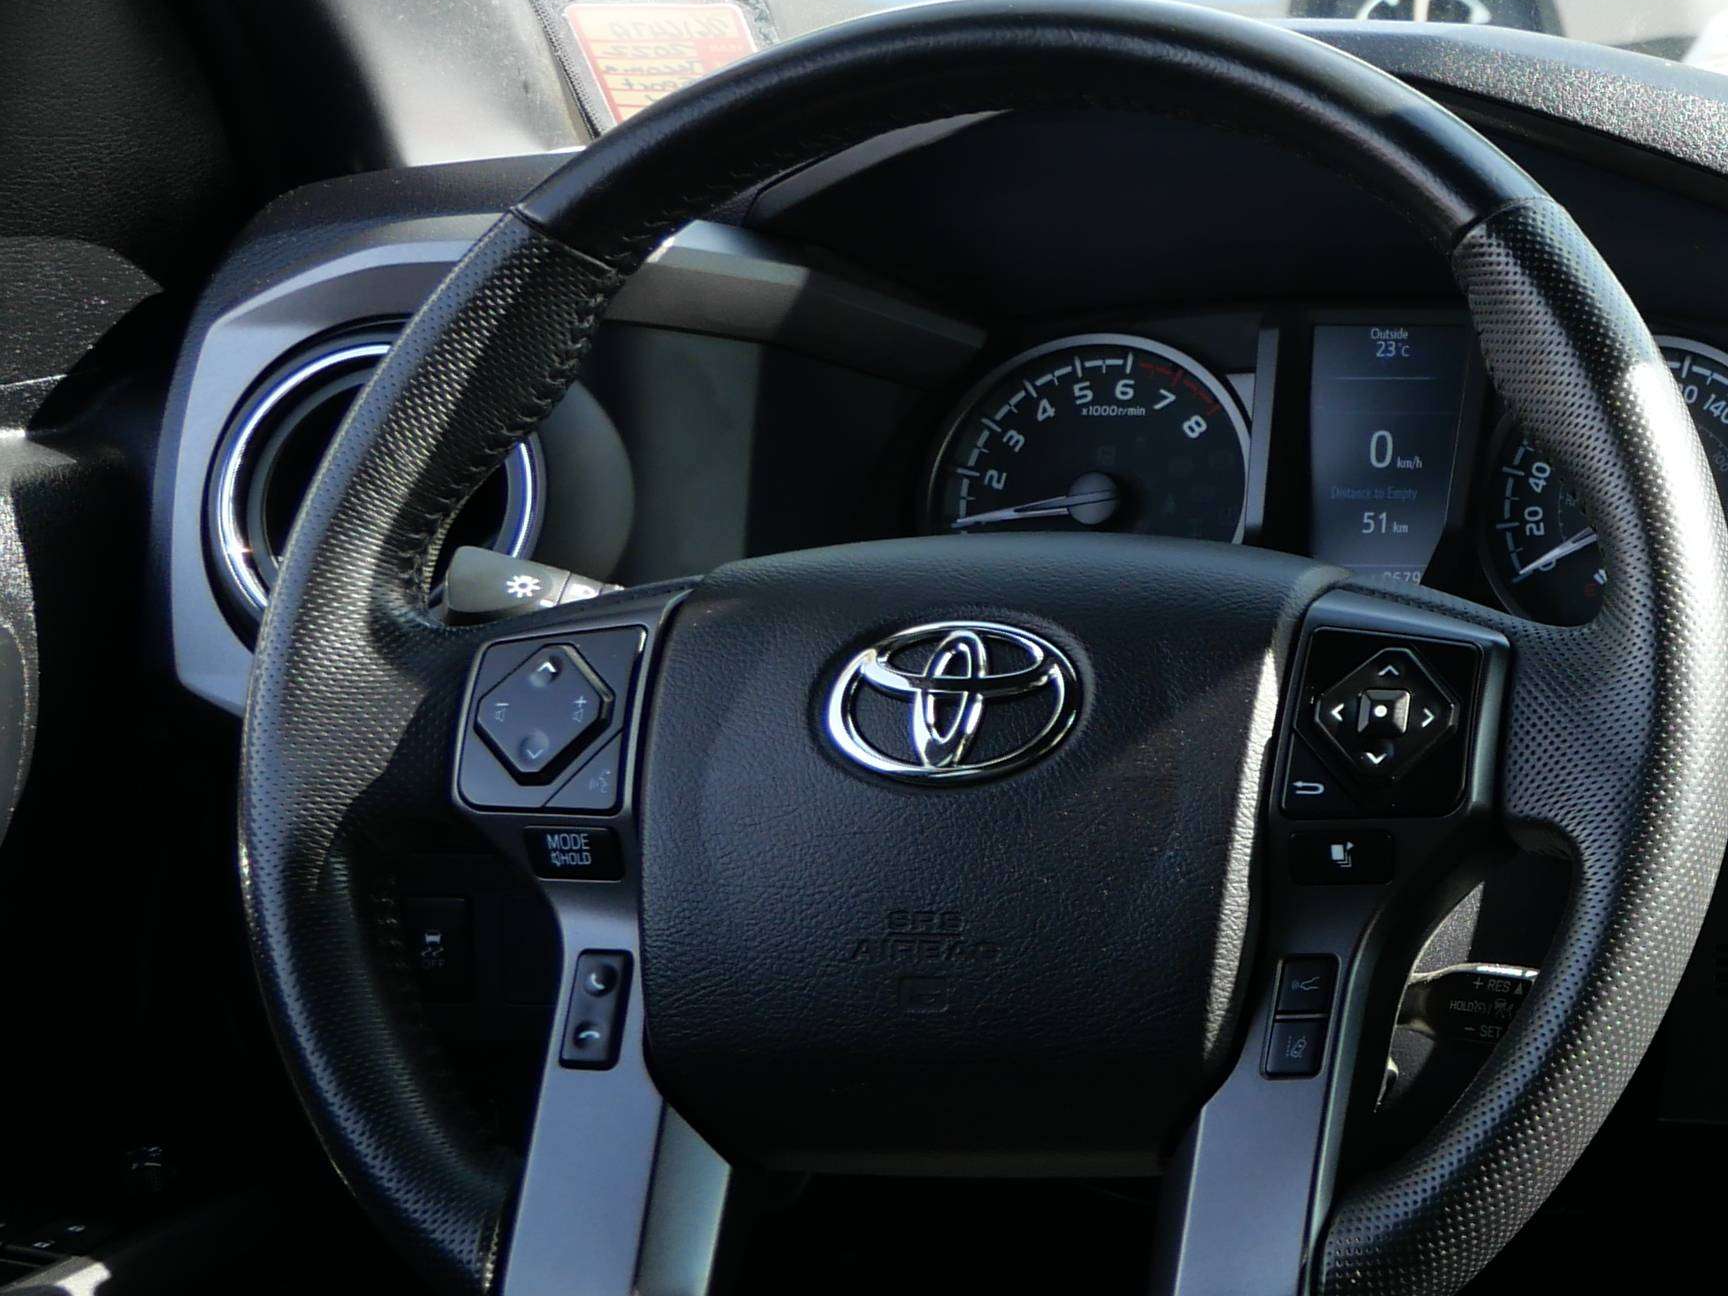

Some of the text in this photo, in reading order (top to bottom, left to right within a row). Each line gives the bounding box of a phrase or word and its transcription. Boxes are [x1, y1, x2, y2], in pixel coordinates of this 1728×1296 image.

[1370, 327, 1409, 340] Outside
[1072, 380, 1094, 405] 5
[1114, 379, 1136, 401] 6
[1153, 388, 1177, 411] 7
[1036, 398, 1056, 423] 4
[1080, 404, 1147, 417] x1000r/min
[1181, 414, 1208, 440] 8
[1001, 428, 1026, 453] 3
[1369, 429, 1422, 470] 0 km/h
[983, 468, 1008, 491] 2
[1527, 460, 1552, 494] 40
[1330, 485, 1419, 502] Distance to Empty
[1361, 511, 1409, 534] 51 km
[1523, 505, 1546, 538] 20
[545, 832, 592, 851] MODE
[561, 851, 592, 866] HOLD
[1486, 978, 1512, 993] RES
[1480, 1023, 1505, 1039] SET
